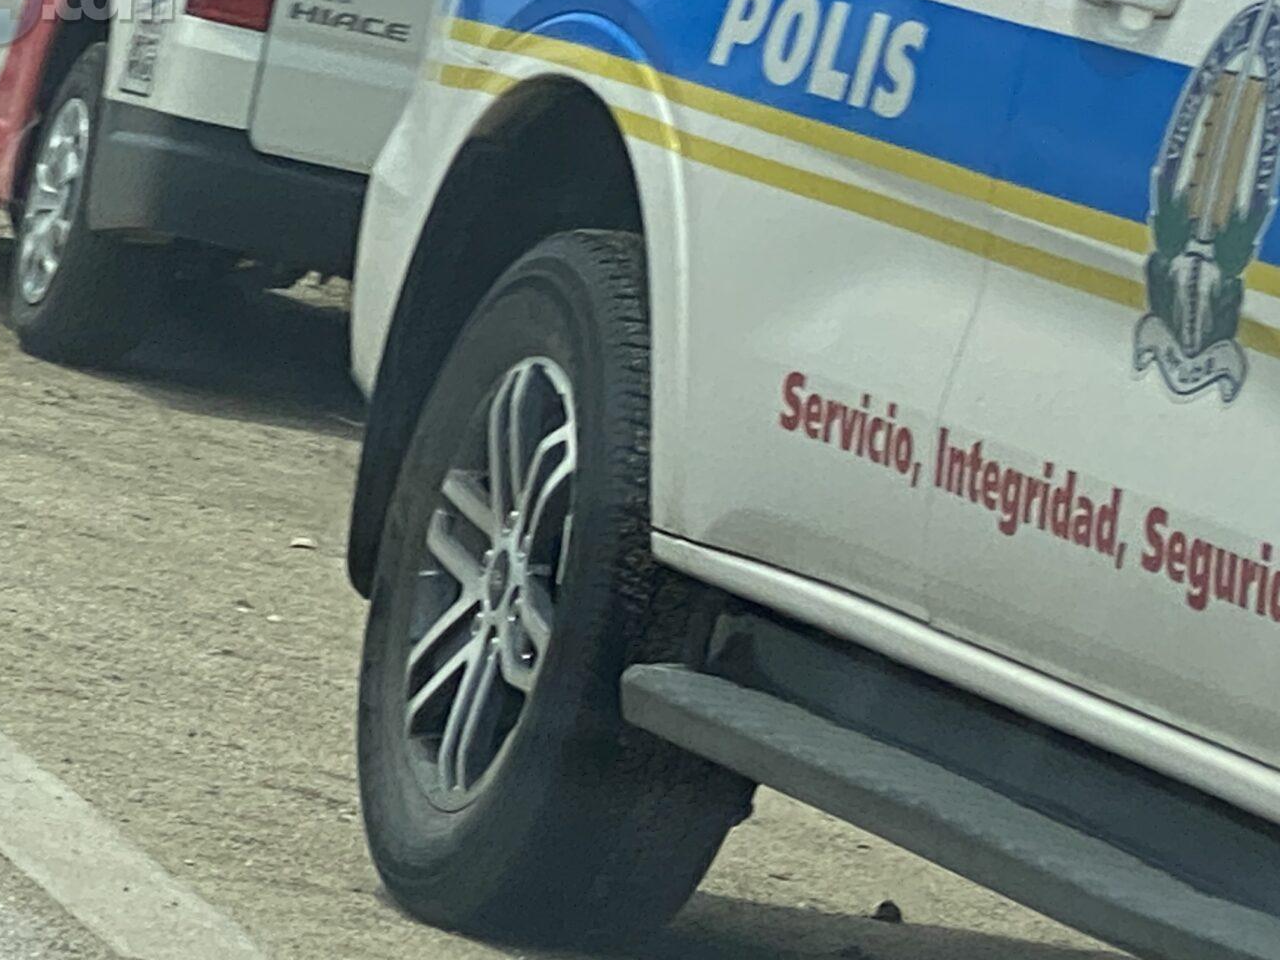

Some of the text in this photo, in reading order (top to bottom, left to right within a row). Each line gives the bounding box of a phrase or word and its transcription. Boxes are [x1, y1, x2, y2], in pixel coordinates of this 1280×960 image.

[289, 2, 412, 42] HIACE
[779, 371, 921, 487] Servicio,
[934, 427, 1127, 569] Integridad,
